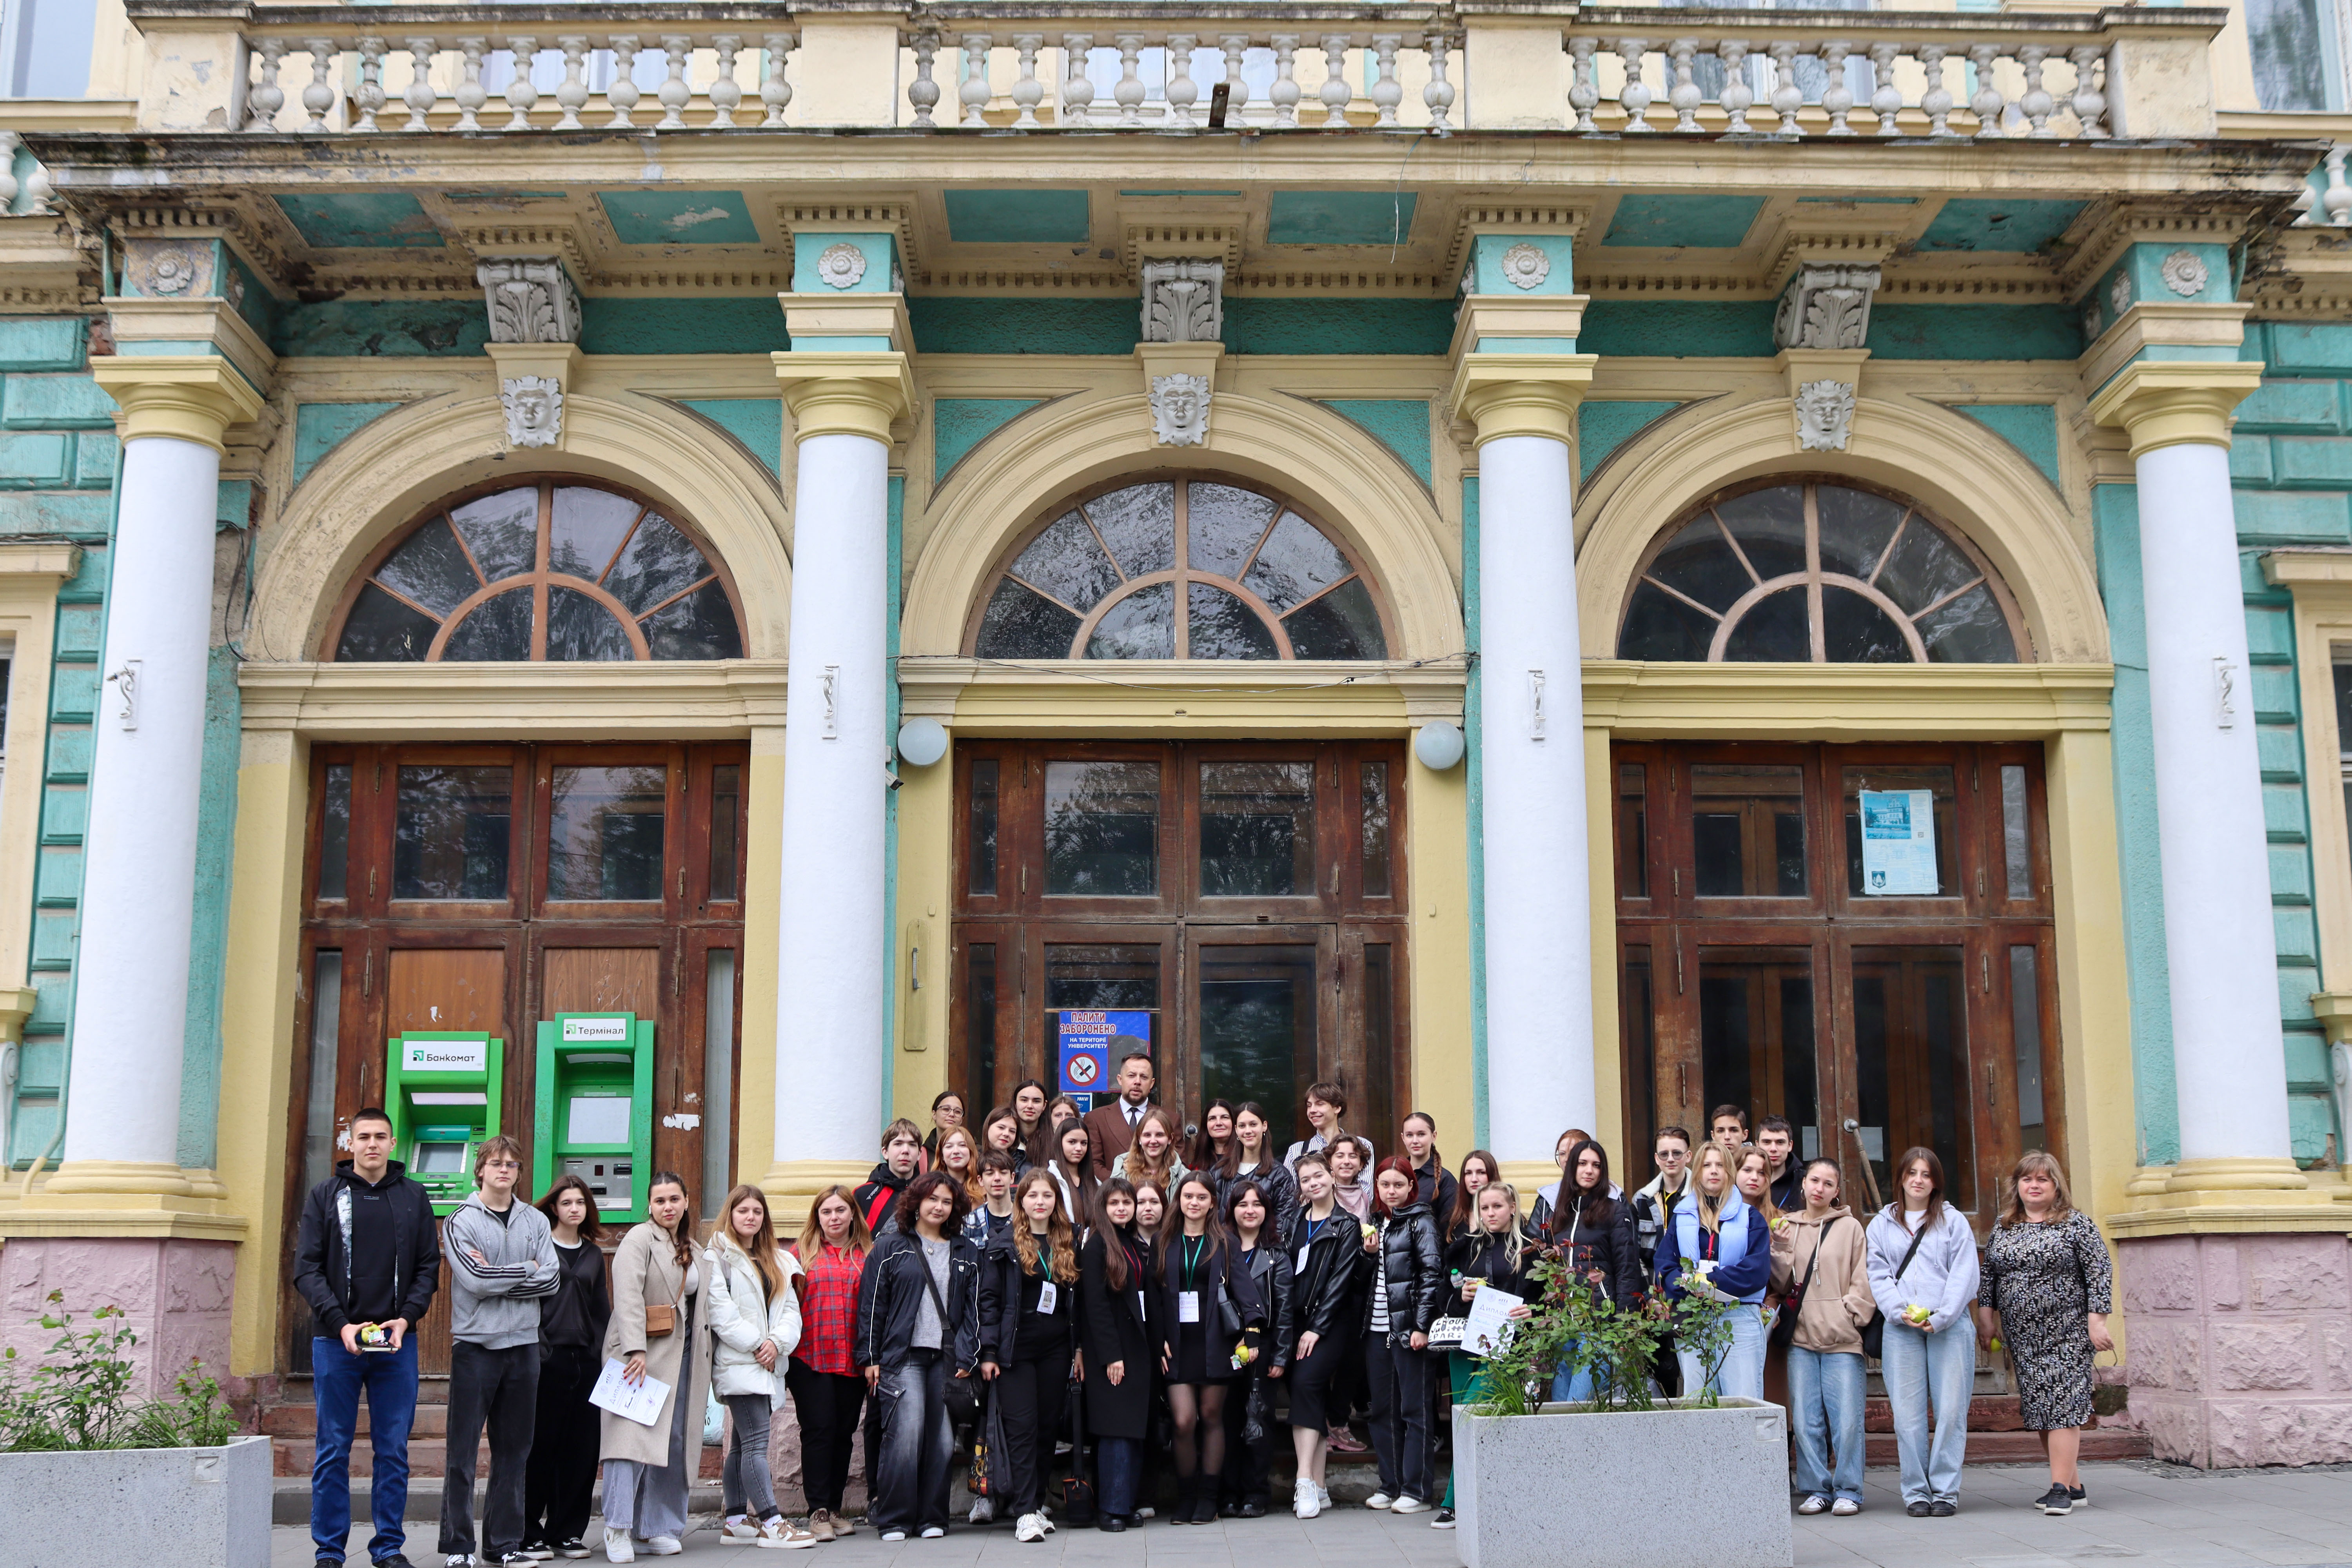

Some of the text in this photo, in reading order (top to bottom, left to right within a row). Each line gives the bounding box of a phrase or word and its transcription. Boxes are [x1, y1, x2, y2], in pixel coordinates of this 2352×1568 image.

[1071, 1012, 1105, 1023] ПАЛИТИ
[578, 1027, 623, 1036] Термінал
[1060, 1024, 1116, 1034] ЗАБОРОНЕНО
